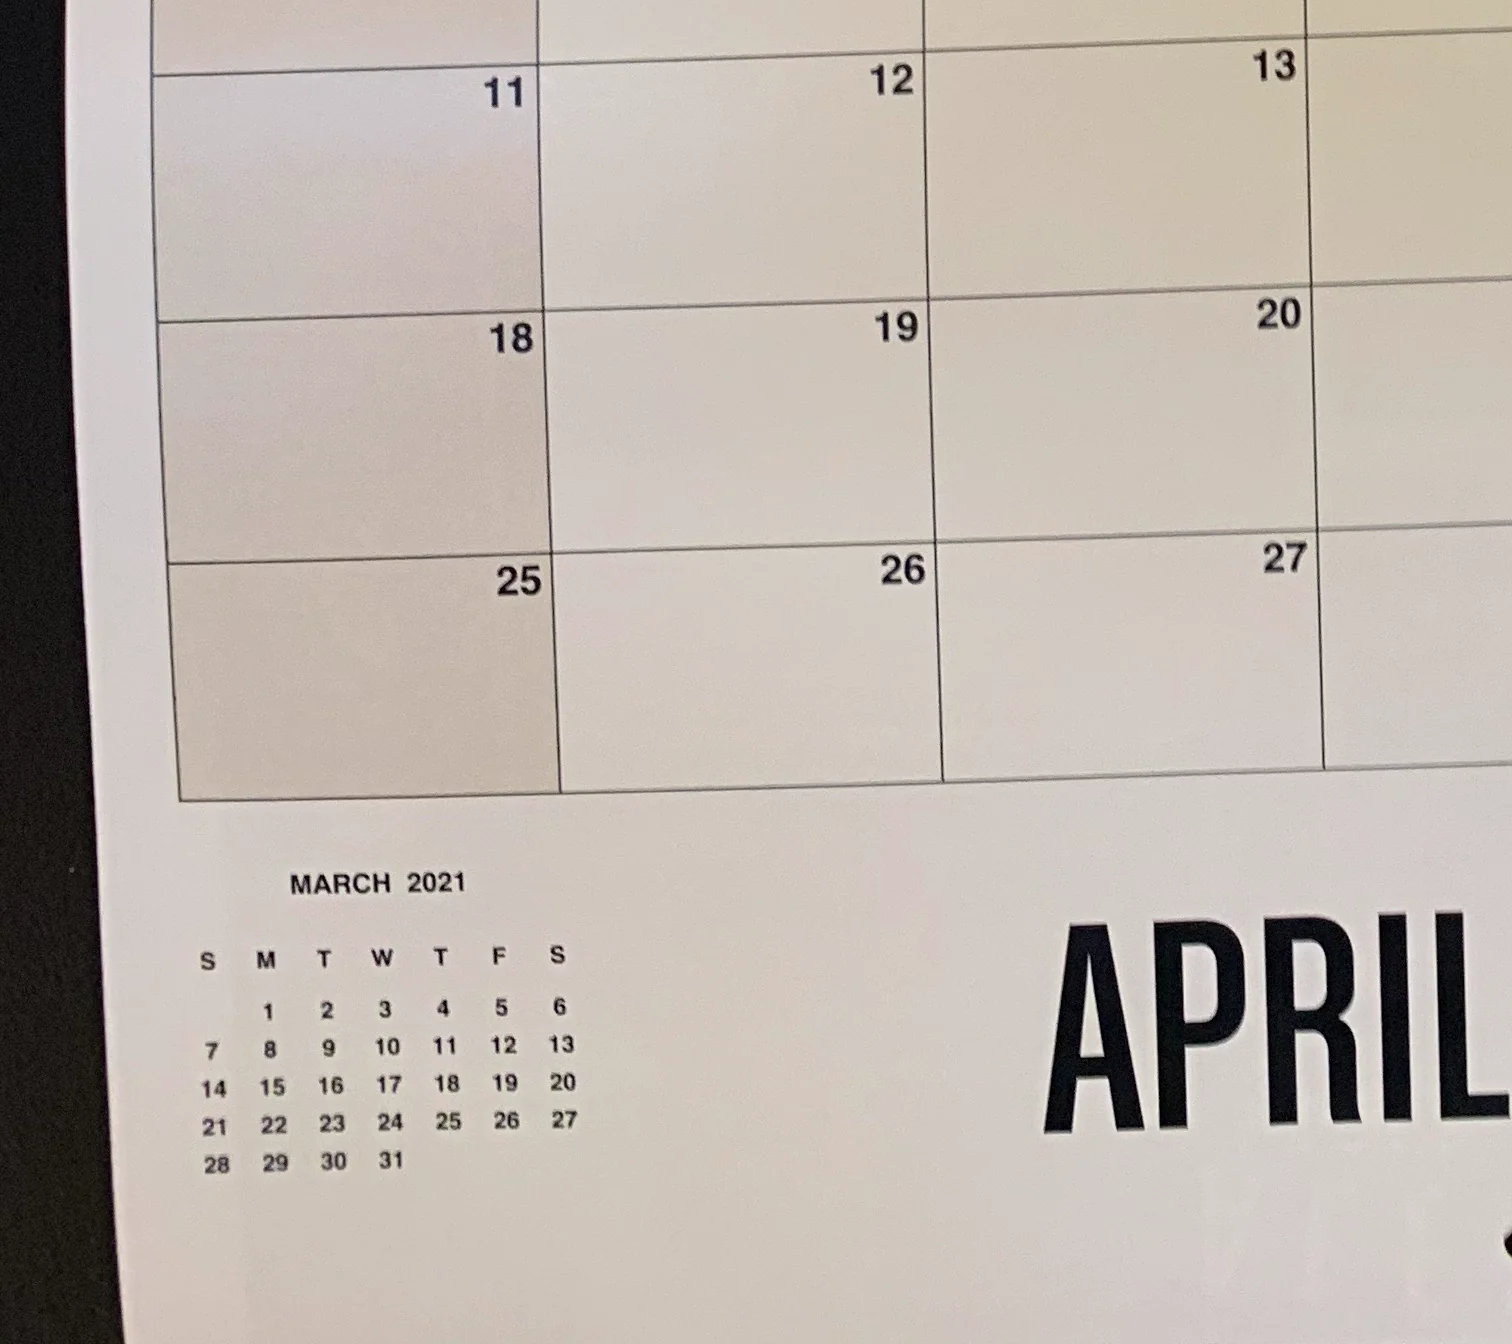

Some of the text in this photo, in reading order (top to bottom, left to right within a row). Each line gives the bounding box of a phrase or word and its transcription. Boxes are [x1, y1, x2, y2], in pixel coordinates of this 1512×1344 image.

[485, 77, 521, 107] 11
[871, 64, 912, 95] 12
[1254, 50, 1295, 81] 13
[491, 323, 532, 353] 18
[876, 311, 918, 341] 19
[1258, 298, 1300, 328] 20
[498, 565, 541, 595] 25
[882, 554, 925, 584] 26
[1264, 542, 1307, 572] 27
[291, 872, 463, 894] MARCH 2021
[201, 946, 565, 970] S M T W T F S
[264, 998, 566, 1020] 1 2 3 4 5 6
[1044, 909, 1511, 1135] APRIL
[205, 1035, 574, 1059] 7 8 9 10 11 12 13
[203, 1073, 575, 1098] 14 15 16 17 18 19 20
[203, 1111, 577, 1136] 21 22 23 24 25 26 27
[205, 1151, 401, 1174] 28 29 30 31
